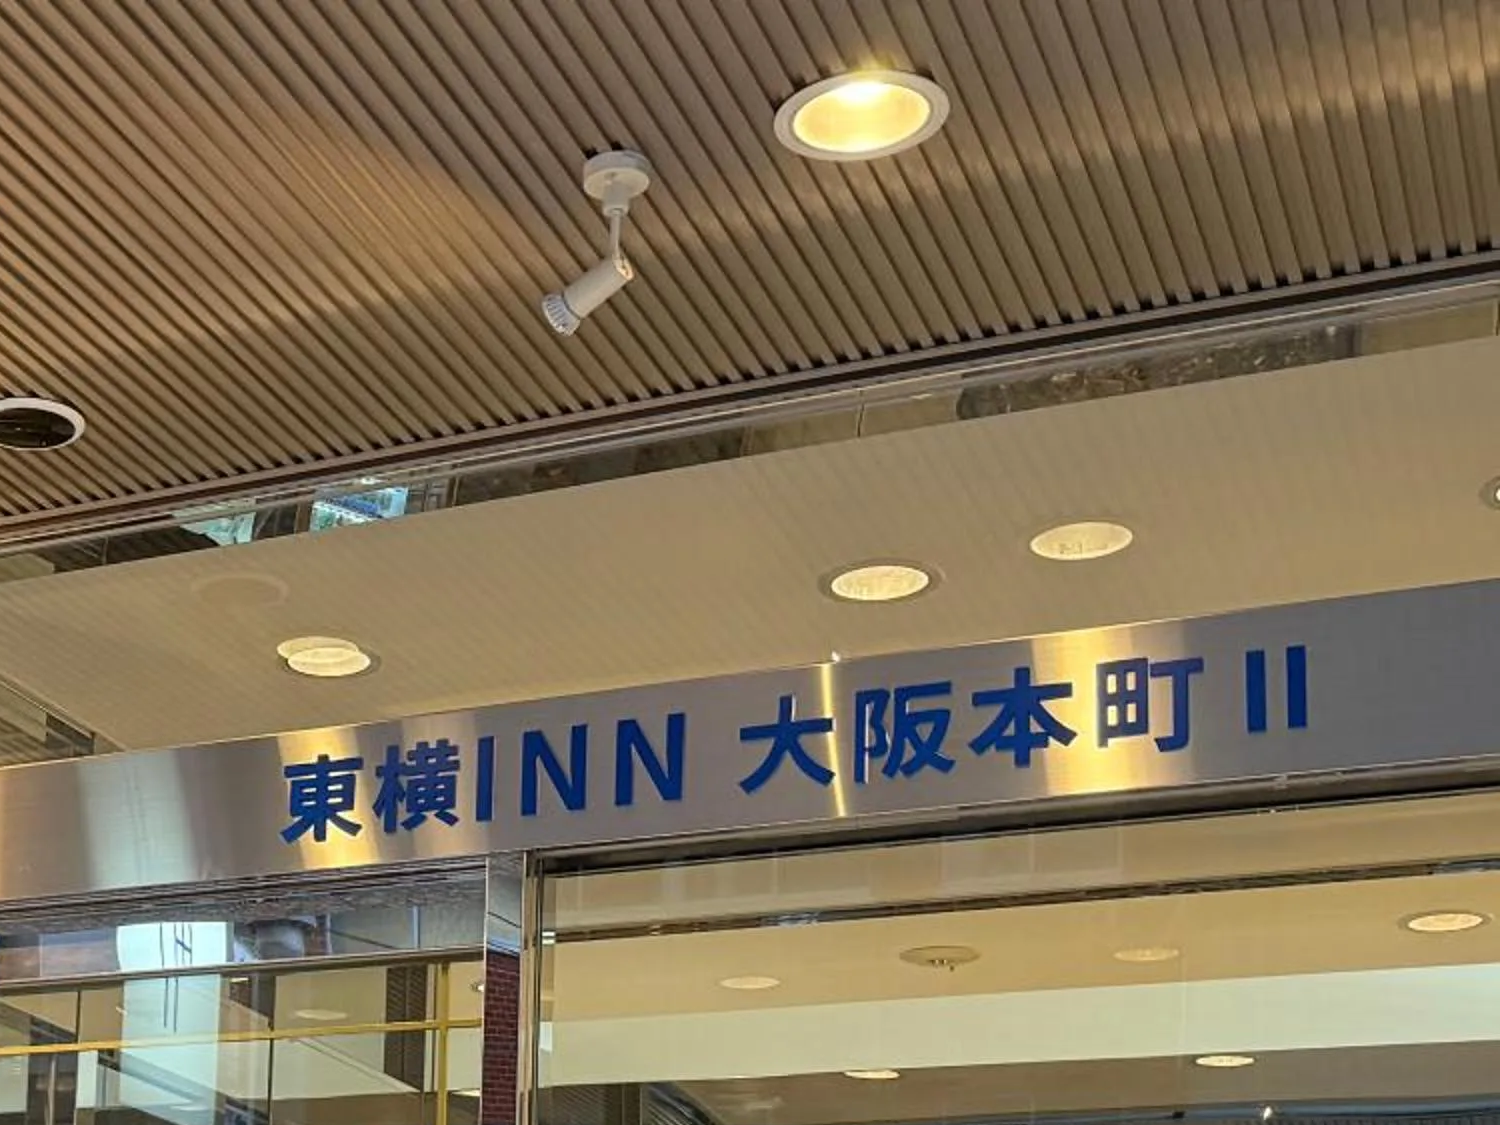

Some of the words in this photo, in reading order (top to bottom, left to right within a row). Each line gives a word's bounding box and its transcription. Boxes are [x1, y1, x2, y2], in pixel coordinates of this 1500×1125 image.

[280, 712, 688, 844] 東横INN
[738, 658, 1203, 796] 大阪本町
